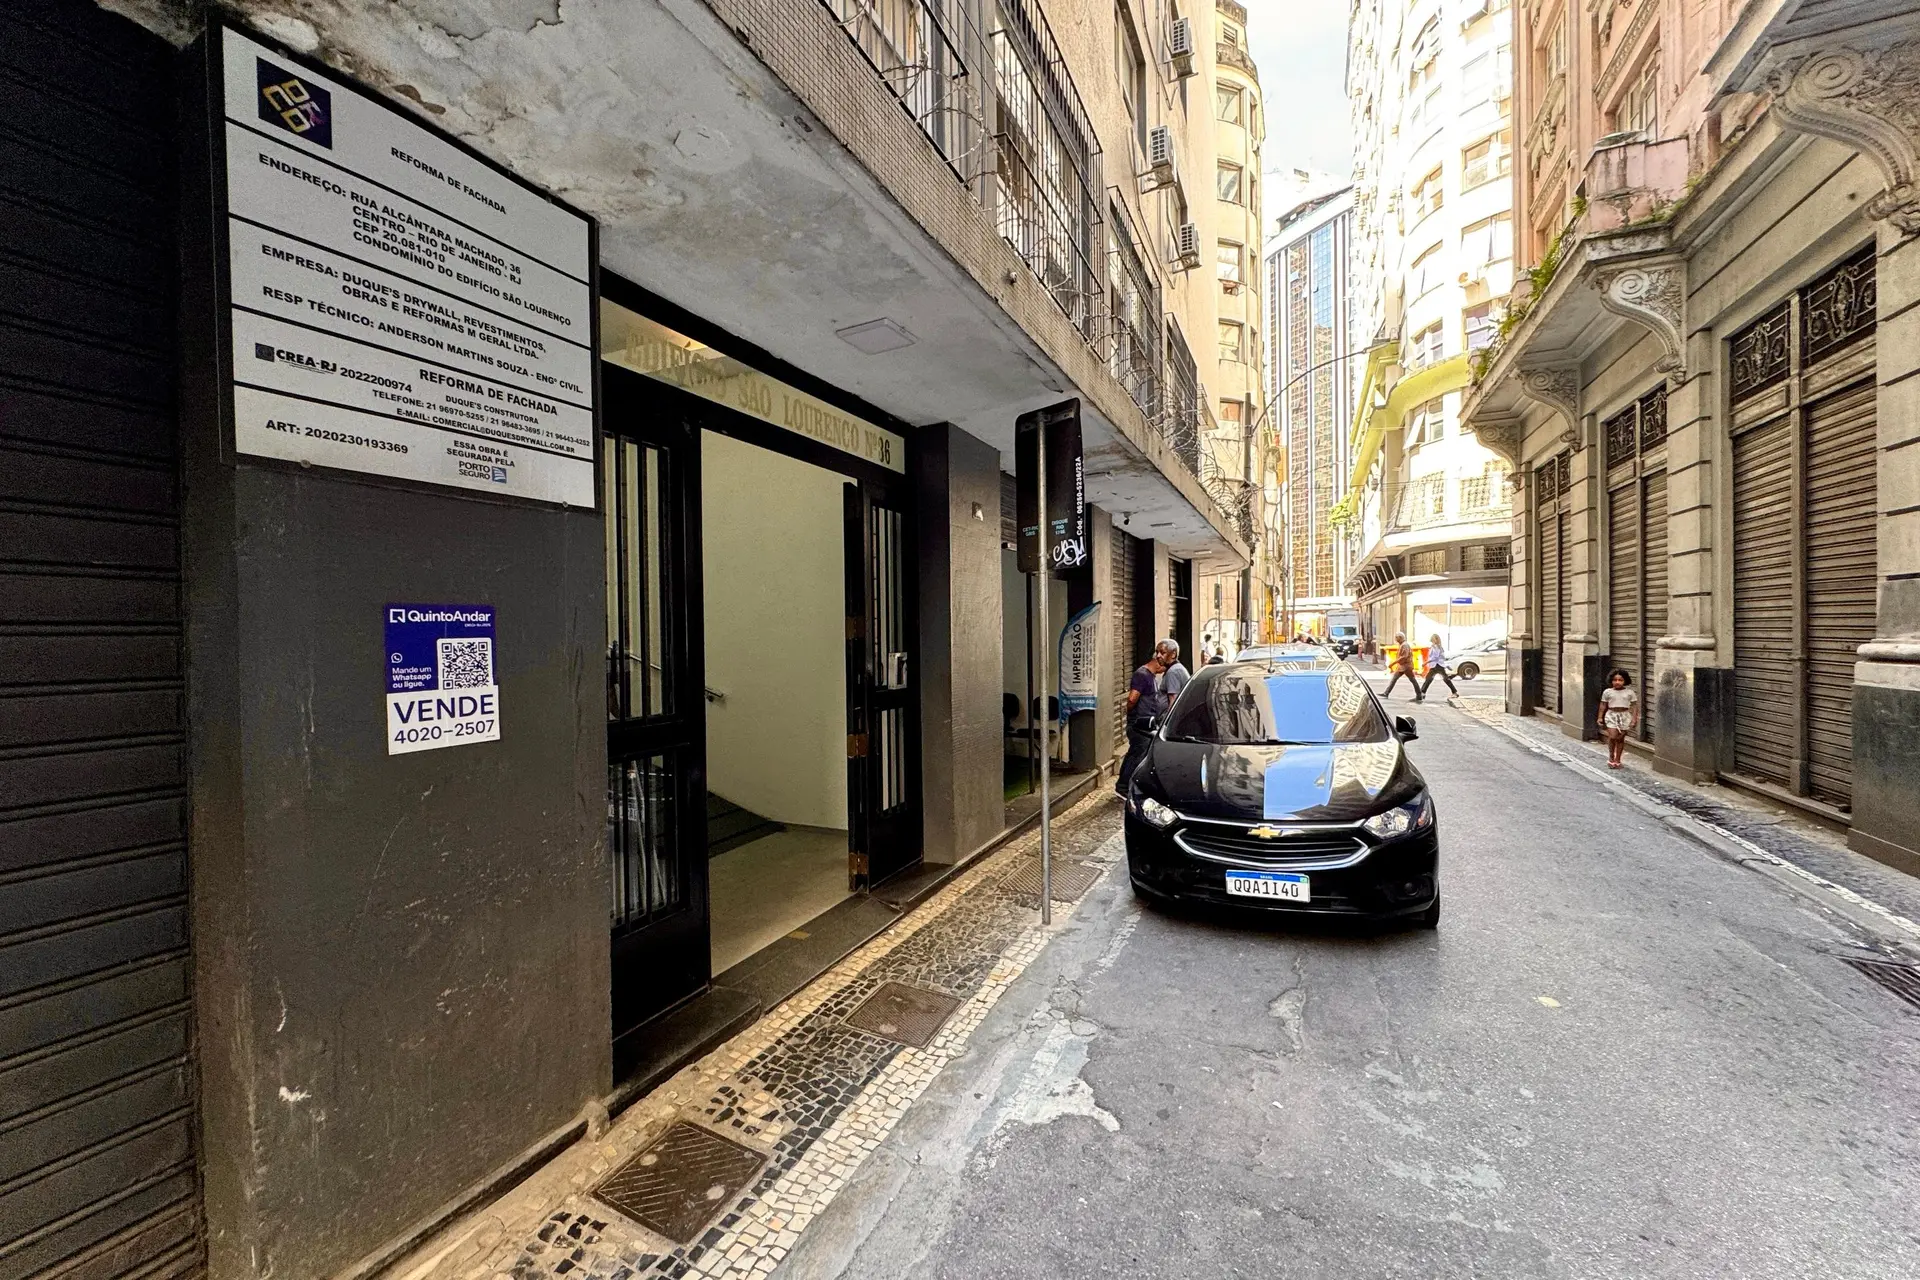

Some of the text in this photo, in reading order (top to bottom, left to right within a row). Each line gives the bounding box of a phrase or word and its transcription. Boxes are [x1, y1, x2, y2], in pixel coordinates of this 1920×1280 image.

[391, 147, 507, 215] REFORMA DE FACHADA
[259, 153, 521, 275] ENDEREÇO: RUA ALCÂNTARA MACHADO, 36
[352, 205, 406, 234] CENTRO
[418, 232, 438, 248] RIO
[441, 243, 456, 257] DE
[458, 252, 502, 277] JANEIRO
[509, 274, 522, 285] RJ
[353, 218, 446, 263] CEP 20.081-010
[353, 231, 571, 326] CONDOMÍNIO DO EDIFÍCIO SÃO LOURENÇO
[261, 244, 547, 353] EMPRESA: DUQUE'S DRYWALL, REVESTIMENTOS,
[262, 286, 303, 305] RESP
[307, 299, 374, 328] TÉCNICO:
[378, 322, 444, 351] ANDERSON
[447, 343, 494, 366] MARTINS
[496, 360, 529, 377] SOUZA
[559, 380, 584, 394] CIVIL.
[342, 285, 540, 360] OBRAS E REFORMAS M GERAL LTDA.
[276, 349, 337, 372] CREA-RJ
[340, 367, 413, 393] 2022200974
[372, 389, 424, 408] TELEFONE:
[426, 402, 437, 411] 21
[490, 417, 499, 425] 21
[419, 369, 558, 416] REFORMA DE FACHADA
[445, 395, 539, 425] DUQUE'S CONSTRUTORA
[396, 408, 431, 422] E-MAIL:
[265, 419, 408, 454] ART: 2020230193369
[453, 440, 476, 451] ESSA
[478, 445, 501, 456] OBRA
[446, 448, 515, 467] SEGURADA PELA
[459, 461, 490, 473] PORTO
[459, 469, 490, 480] SEGURO
[407, 610, 491, 623] QuintoAndar
[392, 674, 432, 682] Whatsapp
[404, 680, 425, 689] ligue.
[393, 694, 495, 724] VENDE
[394, 719, 495, 744] 4020-2507
